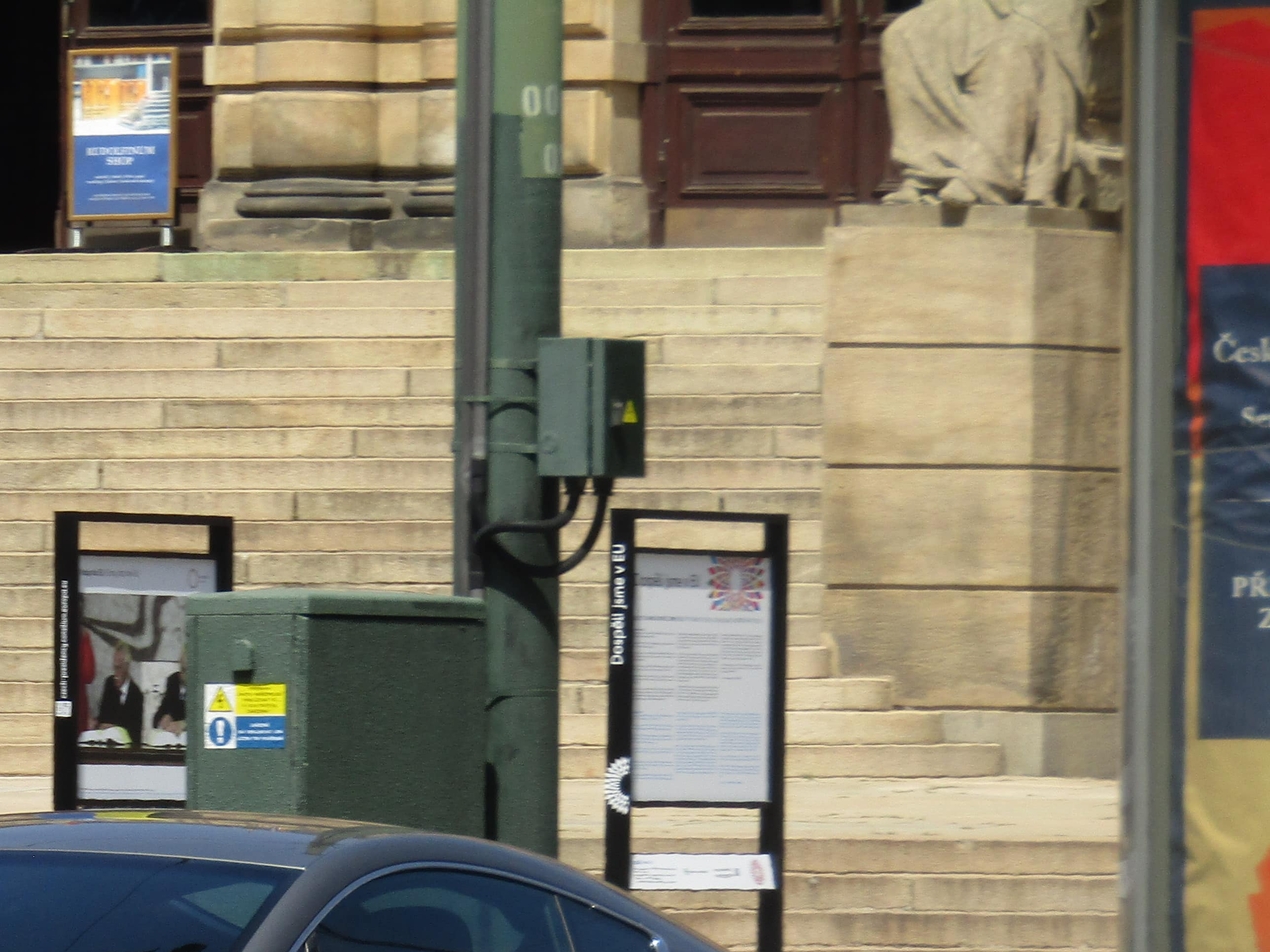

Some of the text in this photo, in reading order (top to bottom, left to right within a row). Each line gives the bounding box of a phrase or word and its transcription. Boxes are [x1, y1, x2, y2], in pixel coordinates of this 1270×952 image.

[611, 543, 626, 562] EU
[613, 564, 626, 574] v
[611, 577, 628, 609] jsme
